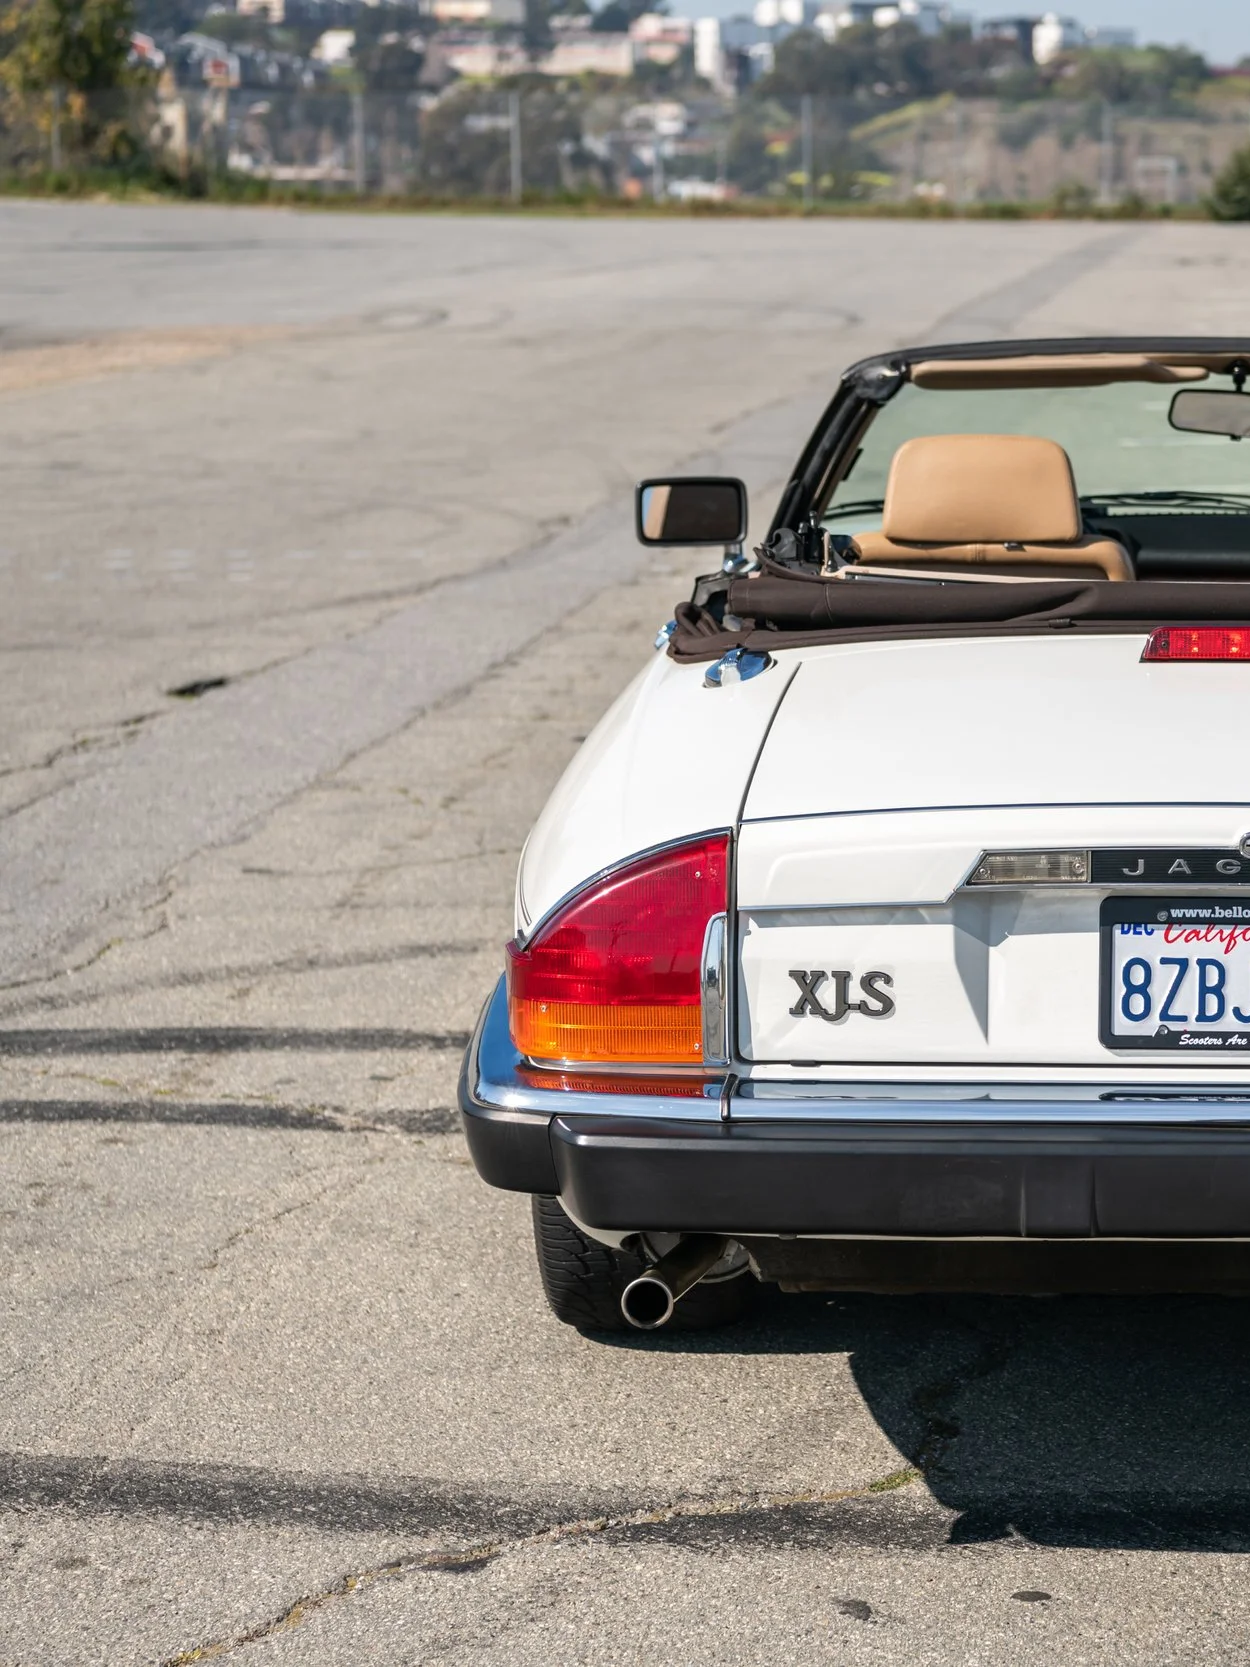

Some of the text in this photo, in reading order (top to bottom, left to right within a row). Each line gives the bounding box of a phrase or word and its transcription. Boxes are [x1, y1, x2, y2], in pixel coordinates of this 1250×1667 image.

[1120, 924, 1155, 936] DEC
[1179, 1034, 1223, 1046] Scooters
[1225, 1034, 1248, 1046] Are
